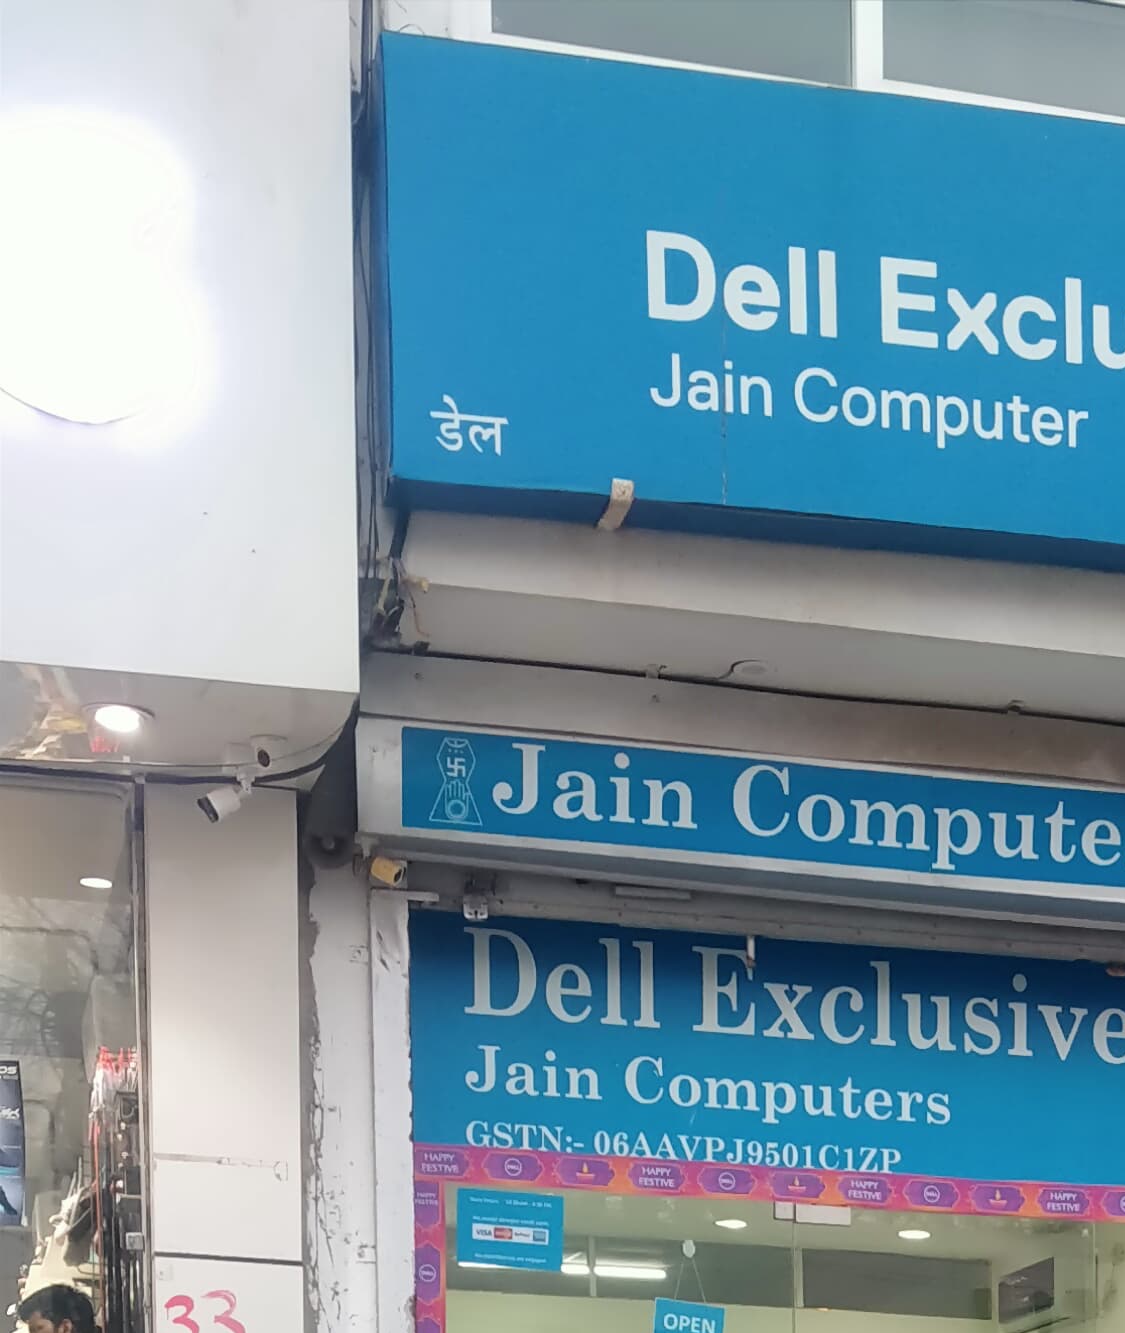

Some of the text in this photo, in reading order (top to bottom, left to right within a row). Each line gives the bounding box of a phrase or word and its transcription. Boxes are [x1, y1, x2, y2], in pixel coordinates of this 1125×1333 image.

[645, 230, 838, 339] Dell
[651, 353, 1090, 449] Jain Computer
[429, 393, 509, 457] डेल
[492, 742, 699, 831] Jain
[464, 925, 661, 1030] Dell
[465, 1044, 952, 1125] Jain Computers
[424, 1152, 456, 1162] HAPPY
[593, 1130, 902, 1174] 06AAVPJ9501C1ZP
[421, 1162, 459, 1173] FESTIVE
[642, 1167, 671, 1177] HAPPY
[639, 1177, 675, 1188] FESTIVE
[851, 1180, 878, 1190] HAPPY
[848, 1189, 882, 1201] FESTIVE
[1050, 1191, 1078, 1202] HAPPY
[1046, 1202, 1080, 1212] FESTIVE
